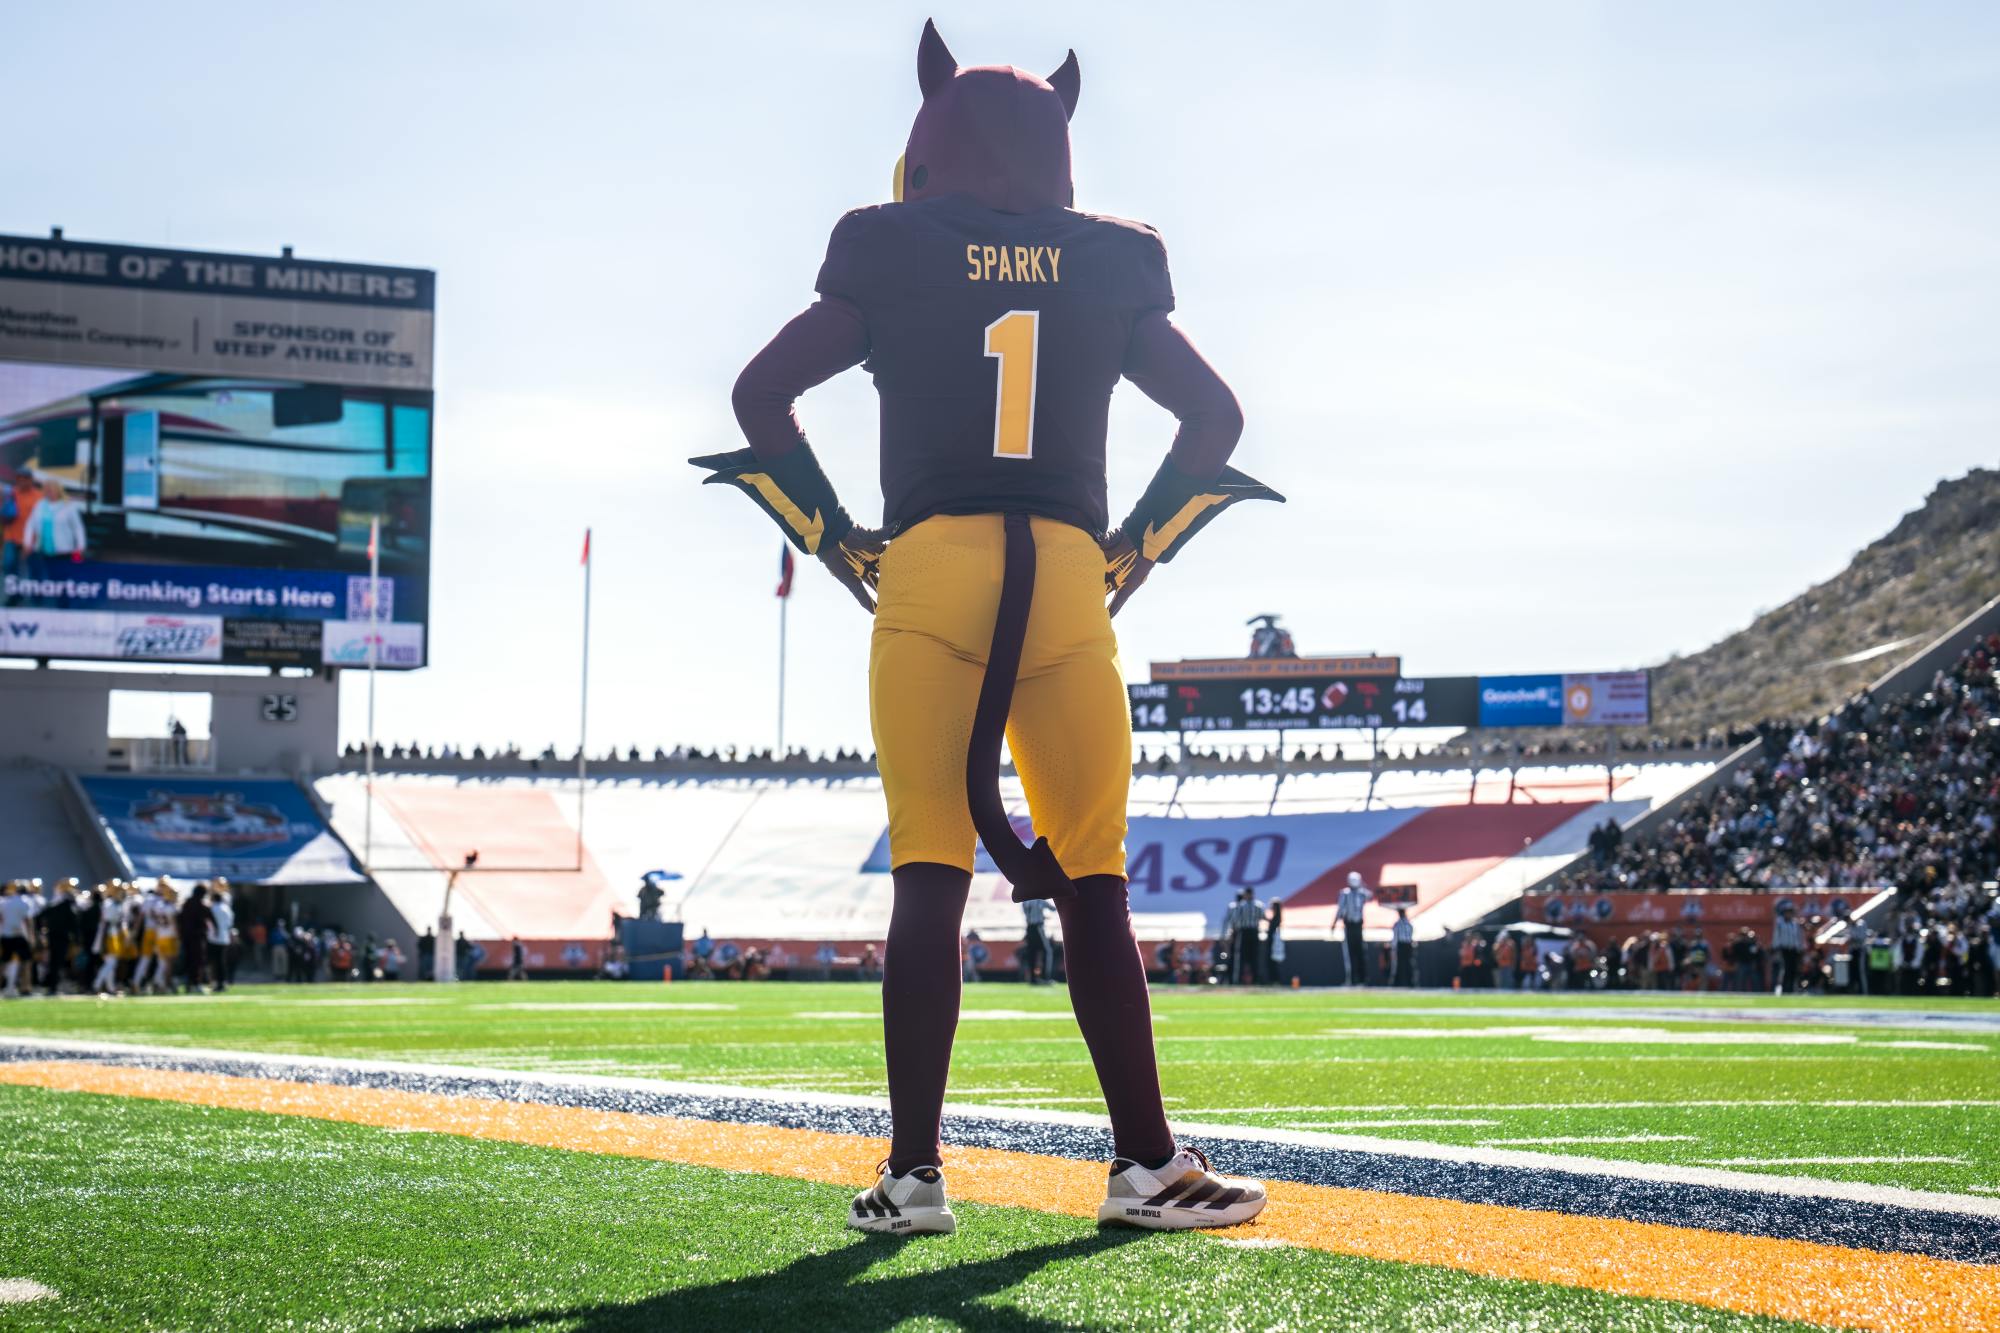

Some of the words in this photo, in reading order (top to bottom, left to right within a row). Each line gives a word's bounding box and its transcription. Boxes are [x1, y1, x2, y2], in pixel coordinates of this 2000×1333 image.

[0, 245, 107, 276] HOME
[119, 255, 171, 280] OF
[182, 260, 254, 288] THE
[265, 266, 417, 299] MINERS
[966, 244, 1061, 282] SPARKY
[87, 329, 165, 348] Company
[233, 321, 354, 346] SPONSOR
[363, 330, 395, 347] OF
[213, 340, 275, 358] UTEP
[285, 345, 414, 367] ATHLETICS
[984, 310, 1039, 459] 1
[4, 574, 101, 599] Smarter
[107, 578, 200, 608] Banking
[206, 582, 277, 606] Starts
[282, 586, 335, 608] Here
[1131, 684, 1168, 699] DUKE
[1394, 680, 1424, 693] ASU
[264, 694, 297, 721] 25
[1240, 686, 1316, 714] 13:45
[1392, 699, 1427, 722] 14
[1134, 704, 1167, 727] 14
[1126, 1208, 1140, 1216] SUN
[1141, 1209, 1161, 1218] DEVILS
